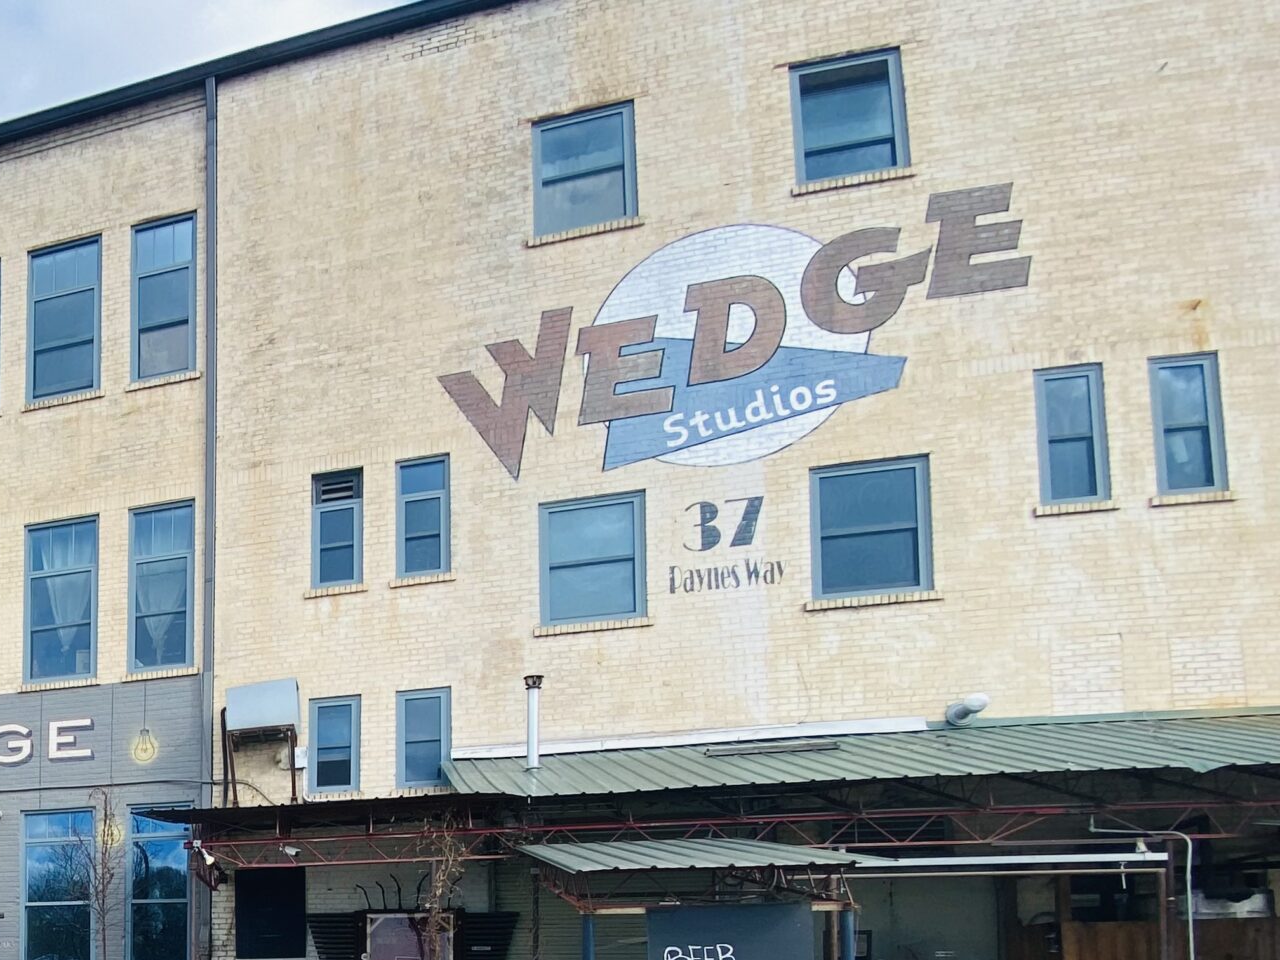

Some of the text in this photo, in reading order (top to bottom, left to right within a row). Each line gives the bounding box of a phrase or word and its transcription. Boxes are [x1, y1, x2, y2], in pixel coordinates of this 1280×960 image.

[437, 182, 1032, 481] WEDGE
[662, 378, 838, 448] Studios
[683, 495, 764, 552] 37
[669, 557, 787, 594] Paynes Way
